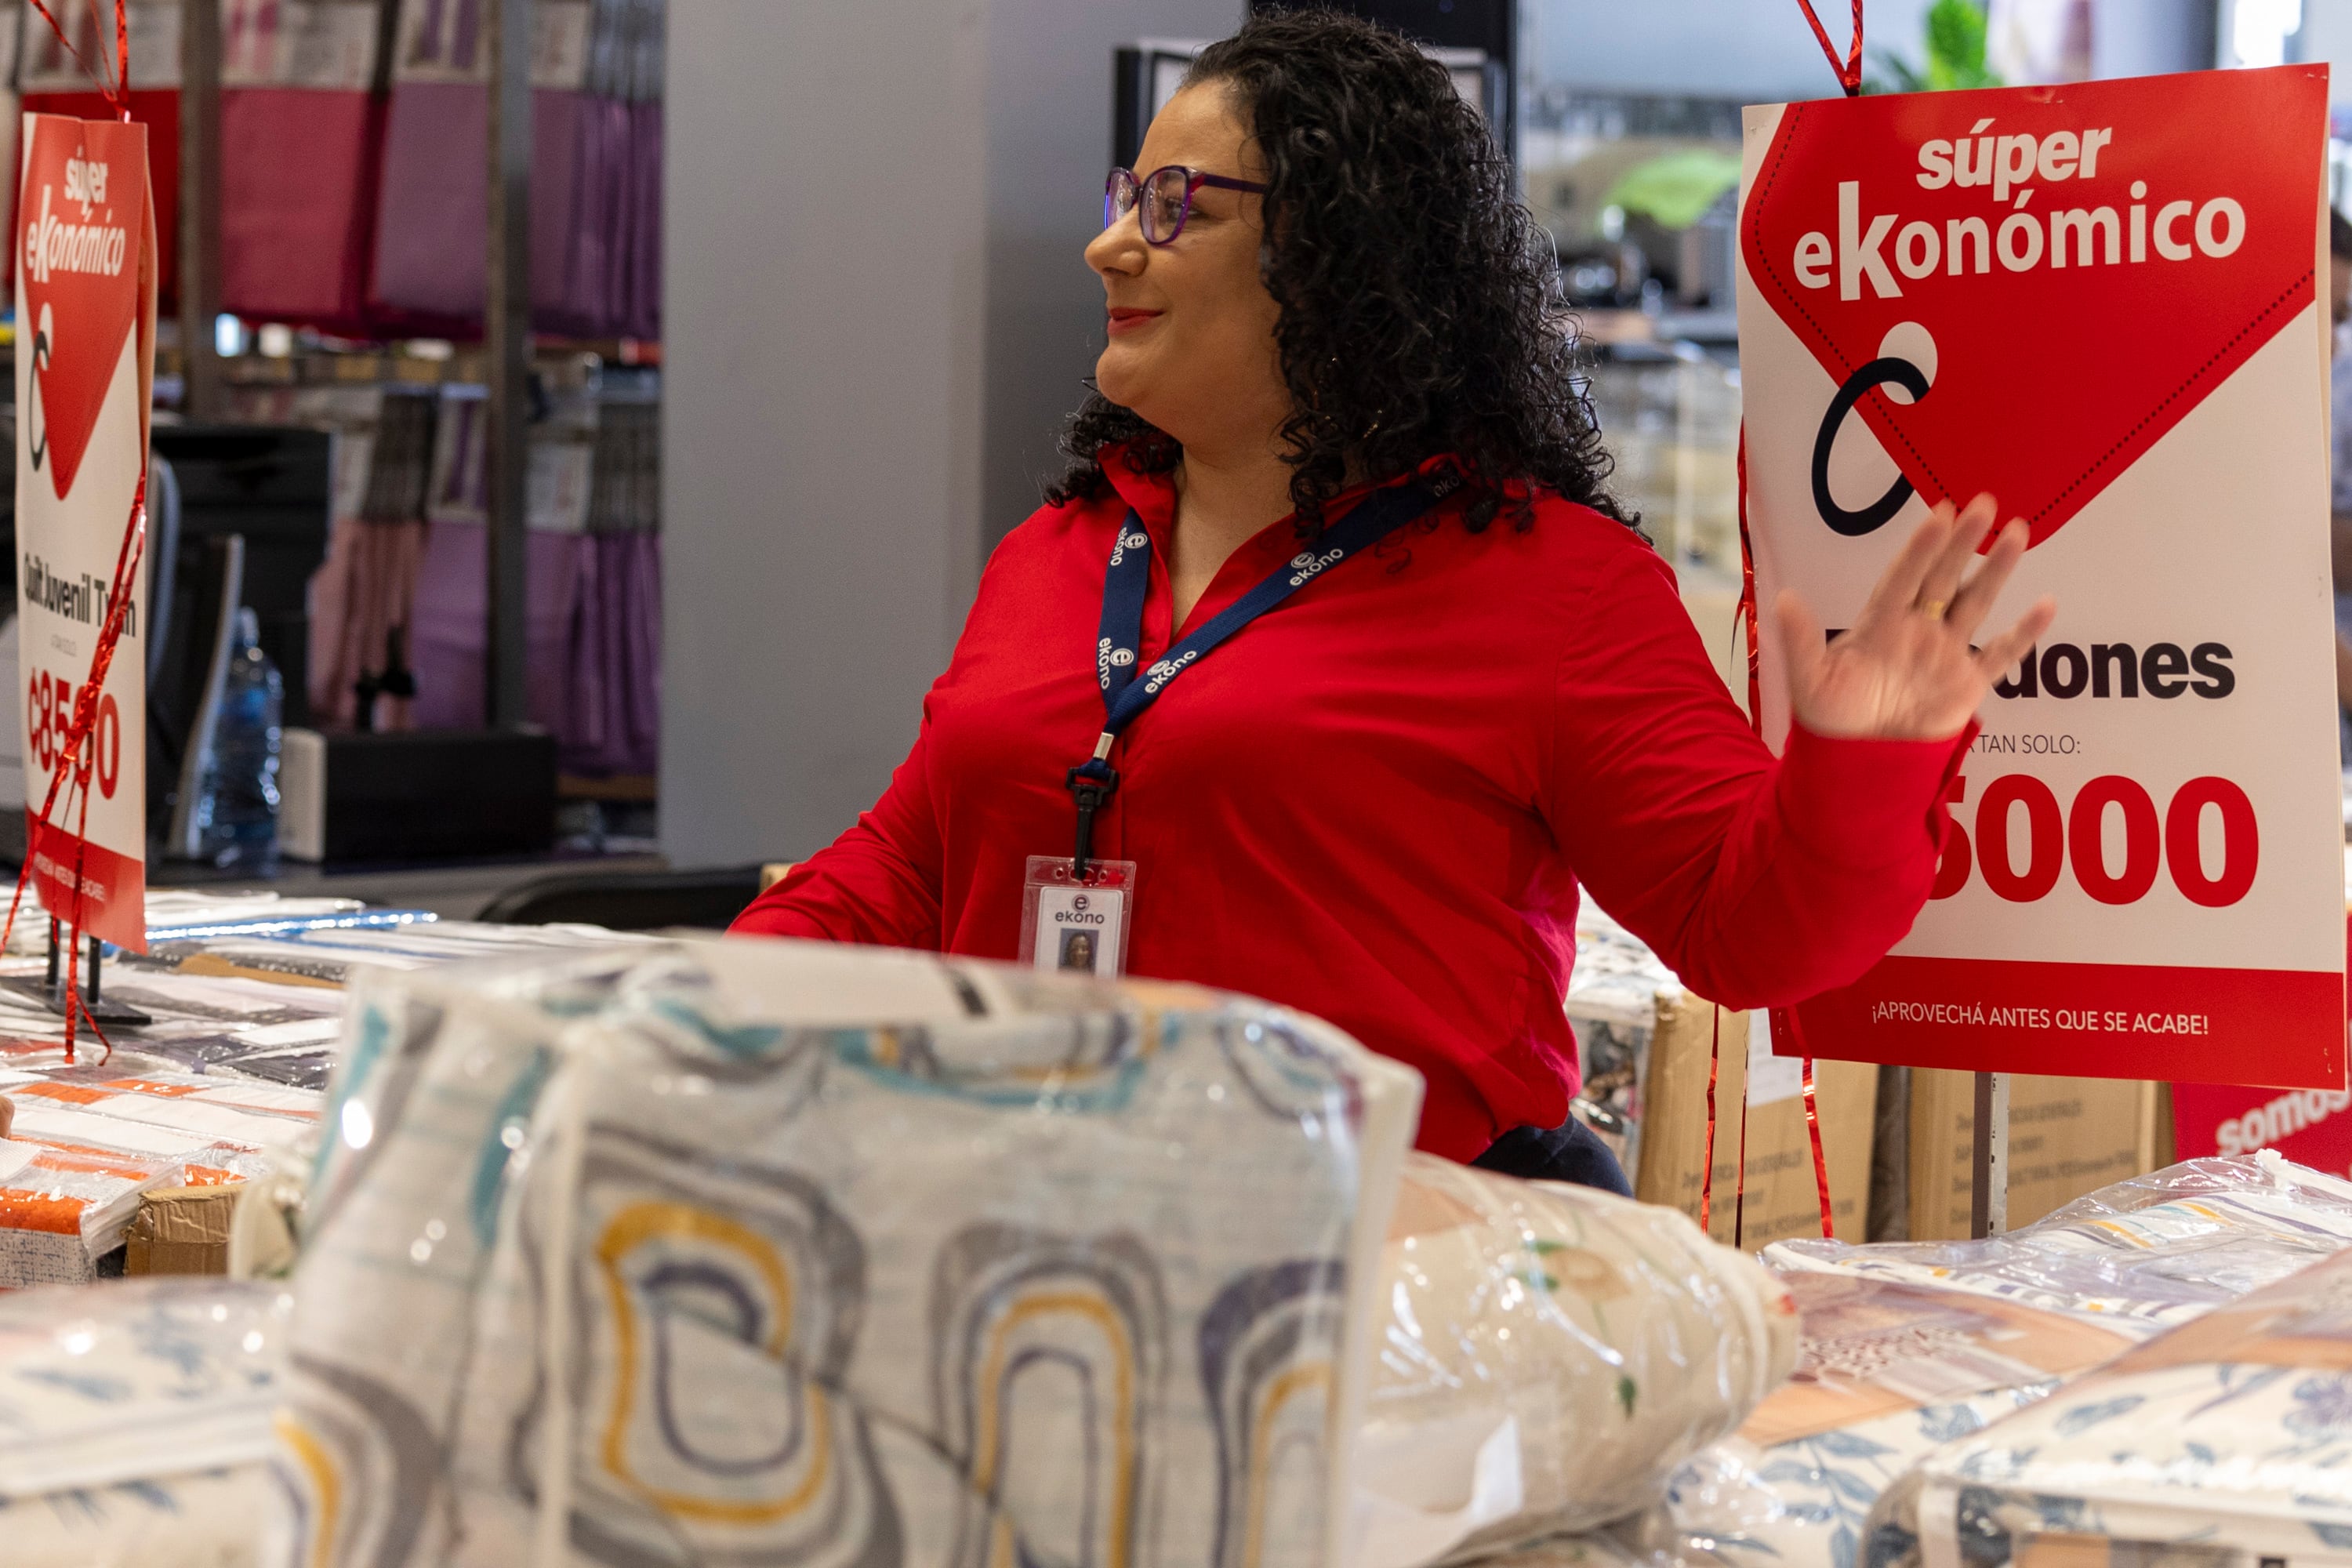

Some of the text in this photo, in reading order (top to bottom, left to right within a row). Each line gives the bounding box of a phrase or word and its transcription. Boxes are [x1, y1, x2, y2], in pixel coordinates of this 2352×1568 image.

[64, 145, 108, 216] súper
[1916, 118, 2113, 202] súper
[26, 183, 126, 284] ekonómico
[1792, 180, 2246, 302] ekonómico
[1109, 526, 1128, 567] ekono
[1289, 548, 1344, 586] ekono
[45, 562, 91, 625] Juvenil
[94, 579, 136, 638] Tn
[1098, 637, 1112, 690] ekono
[1145, 651, 1197, 694] ekono
[1977, 734, 2016, 754] TAN
[2021, 734, 2081, 755] SOLO:
[1054, 911, 1105, 924] ekono
[1871, 1001, 2209, 1036] ¡APROVECHÁ ANTES QUE SE ACABE!
